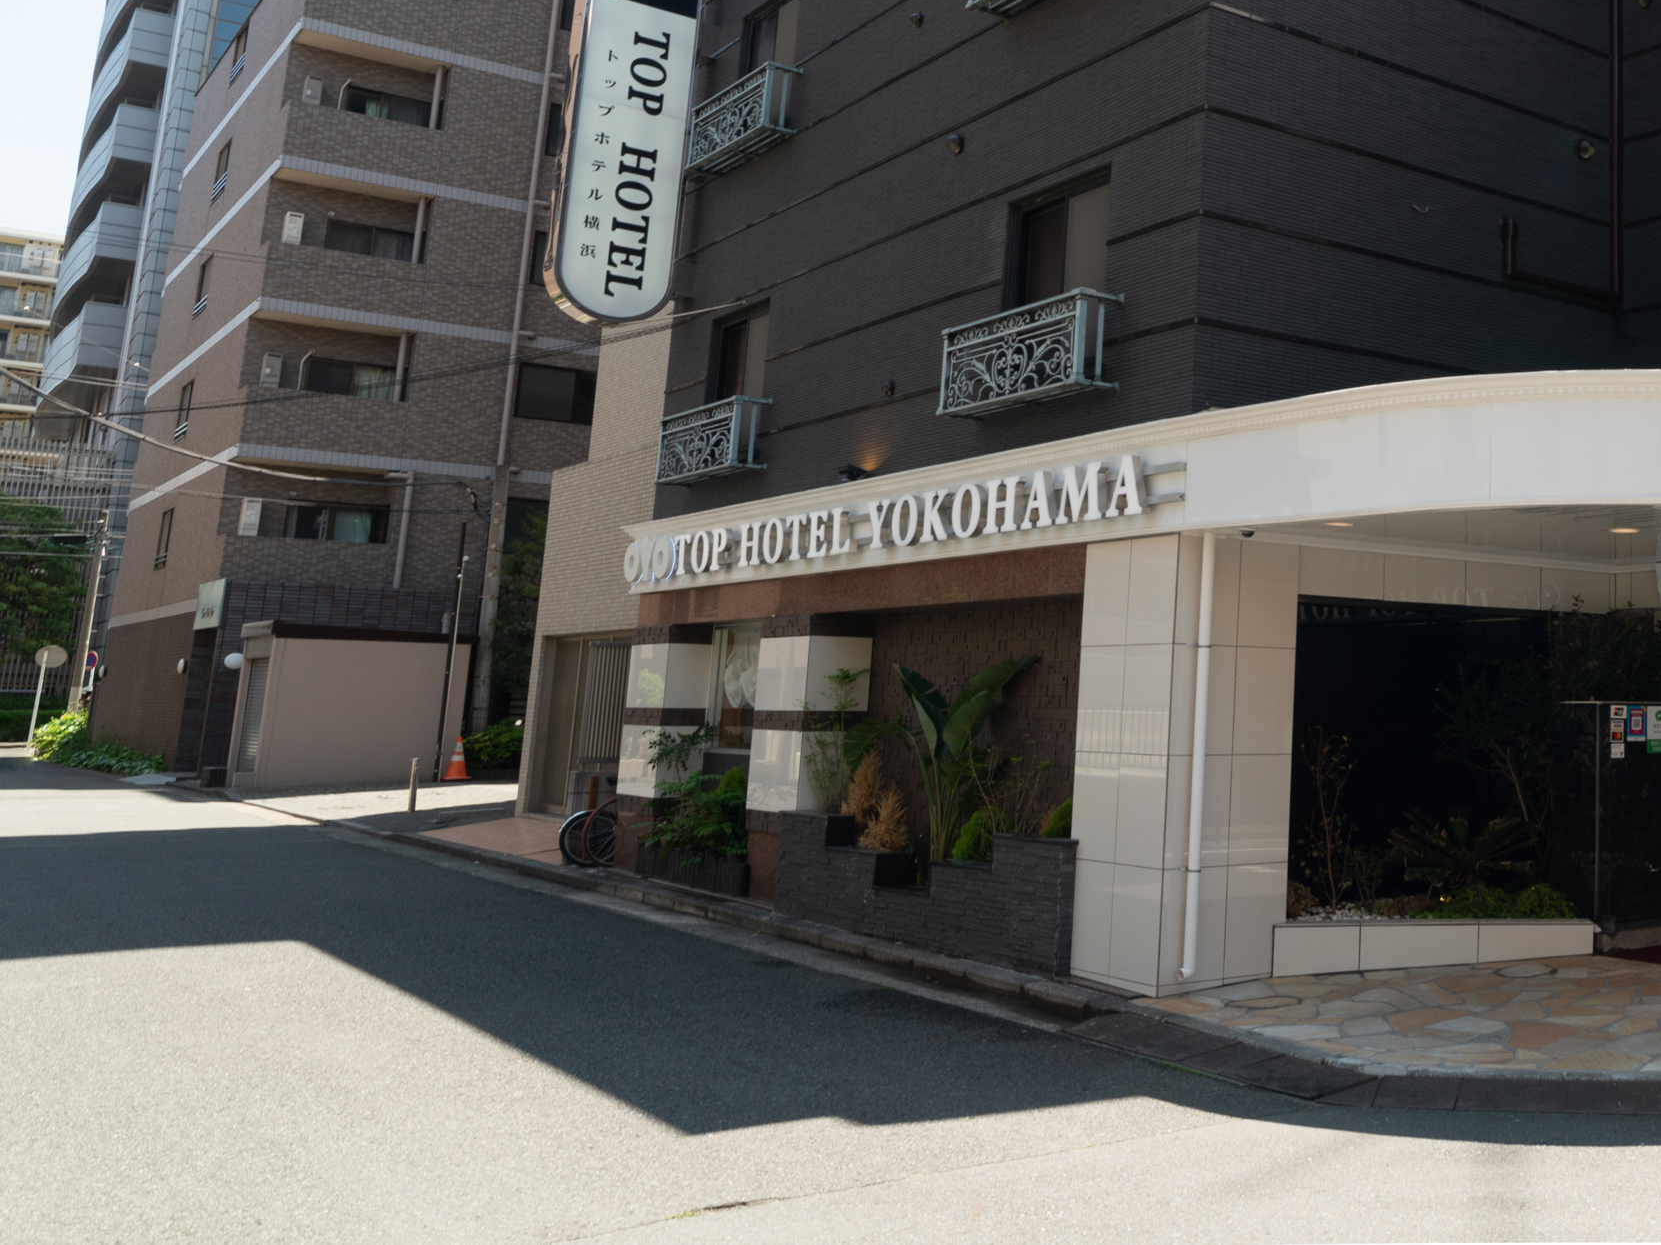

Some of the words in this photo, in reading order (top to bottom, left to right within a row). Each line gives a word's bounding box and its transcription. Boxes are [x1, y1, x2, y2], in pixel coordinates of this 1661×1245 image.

[628, 31, 671, 116] TOP
[580, 49, 618, 259] トップホテル横浜
[604, 142, 658, 298] HOTEL
[624, 536, 676, 583] OYO
[676, 527, 731, 575] TOP
[738, 506, 852, 567] HOTEL
[868, 455, 1146, 549] YOKOHAMA
